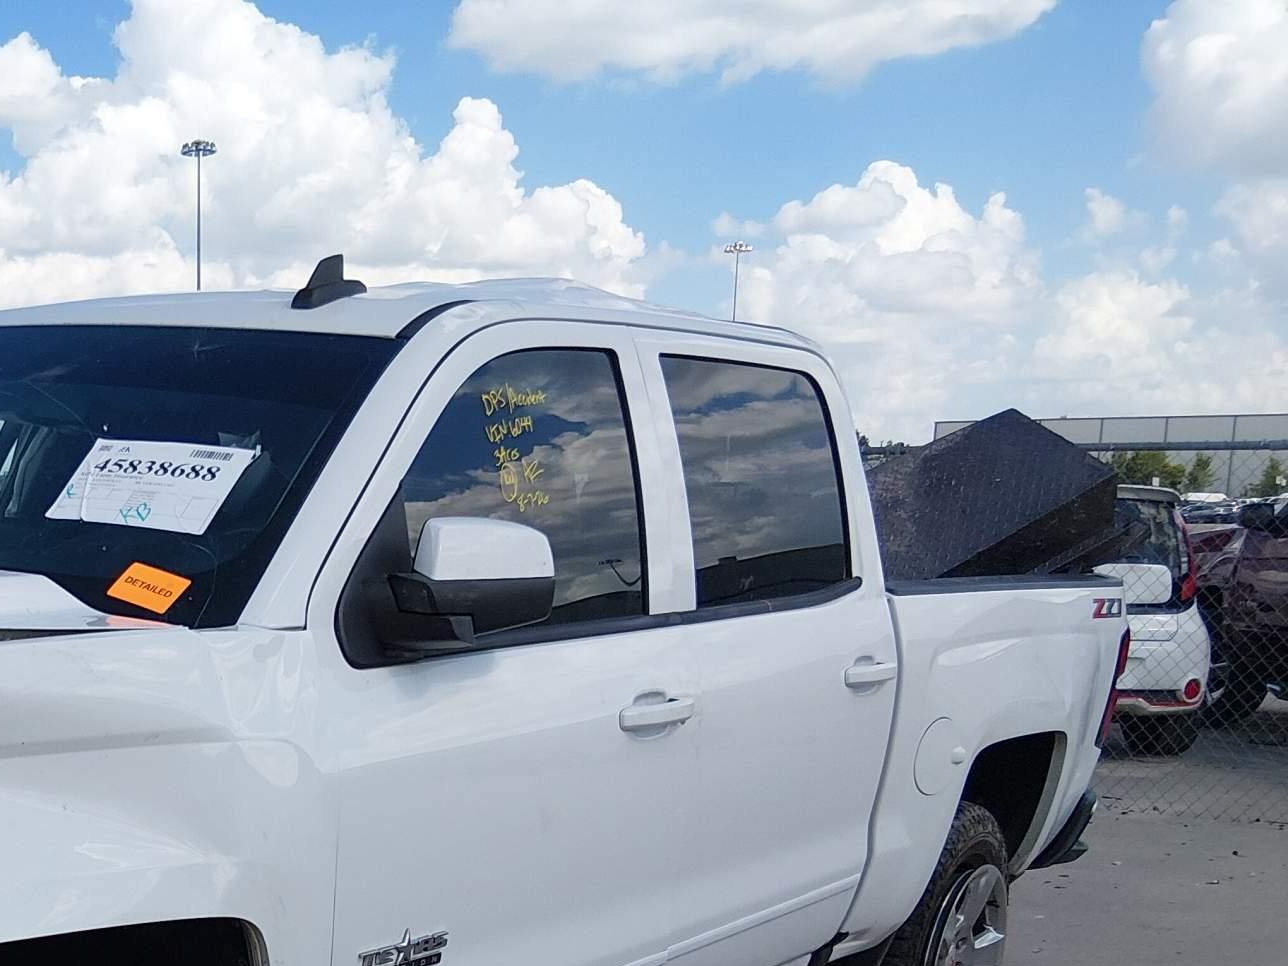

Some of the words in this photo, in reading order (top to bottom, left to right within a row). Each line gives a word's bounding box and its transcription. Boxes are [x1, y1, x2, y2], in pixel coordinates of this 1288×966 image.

[94, 458, 221, 482] 45838688
[124, 575, 174, 599] DETAILED
[1092, 598, 1122, 619] Z71
